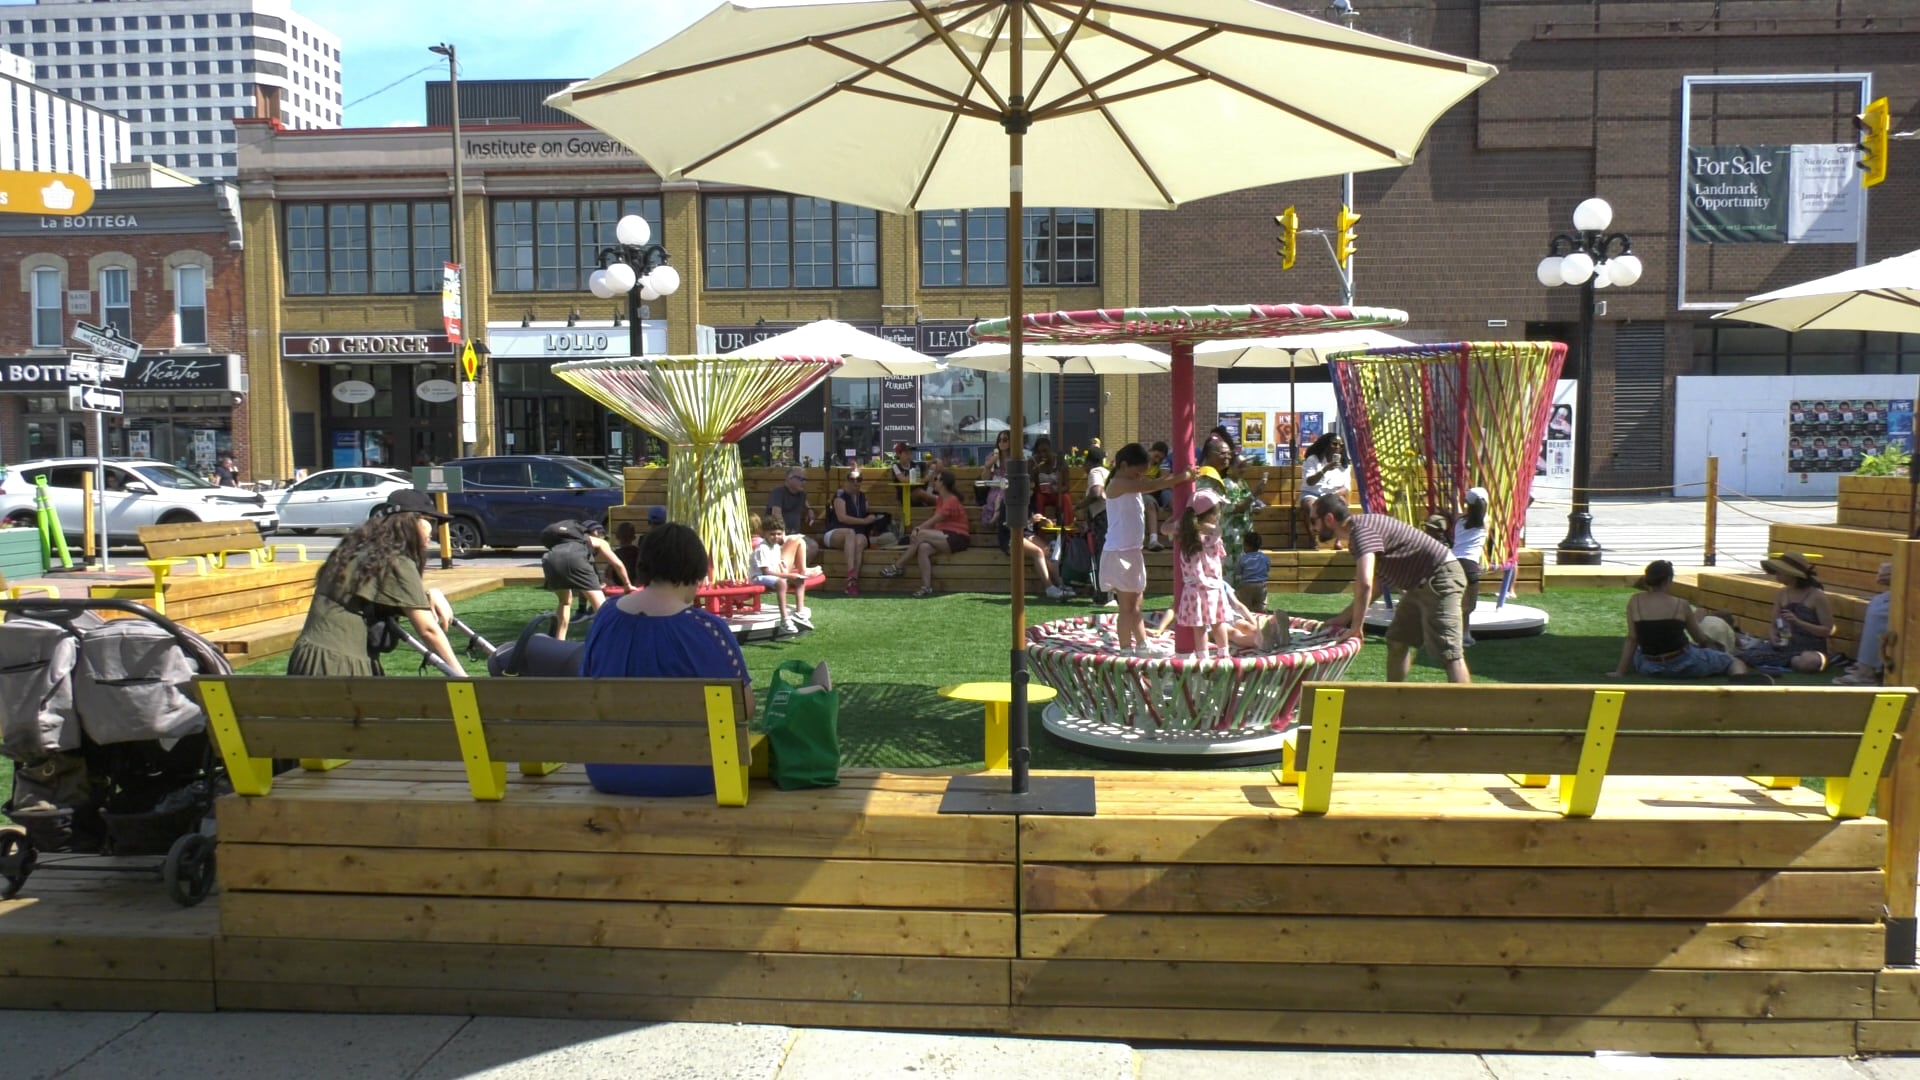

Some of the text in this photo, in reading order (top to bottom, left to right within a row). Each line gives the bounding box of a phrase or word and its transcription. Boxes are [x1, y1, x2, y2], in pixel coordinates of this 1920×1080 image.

[467, 138, 633, 155] Institute on Govern
[1695, 155, 1773, 176] For Sale
[1694, 183, 1758, 196] Landmark
[1694, 196, 1771, 211] Opportunity
[41, 215, 138, 228] La BOTTEGA
[90, 335, 123, 353] GEORGE
[308, 336, 429, 354] 60 GEORGE
[546, 333, 608, 351] LOLLO
